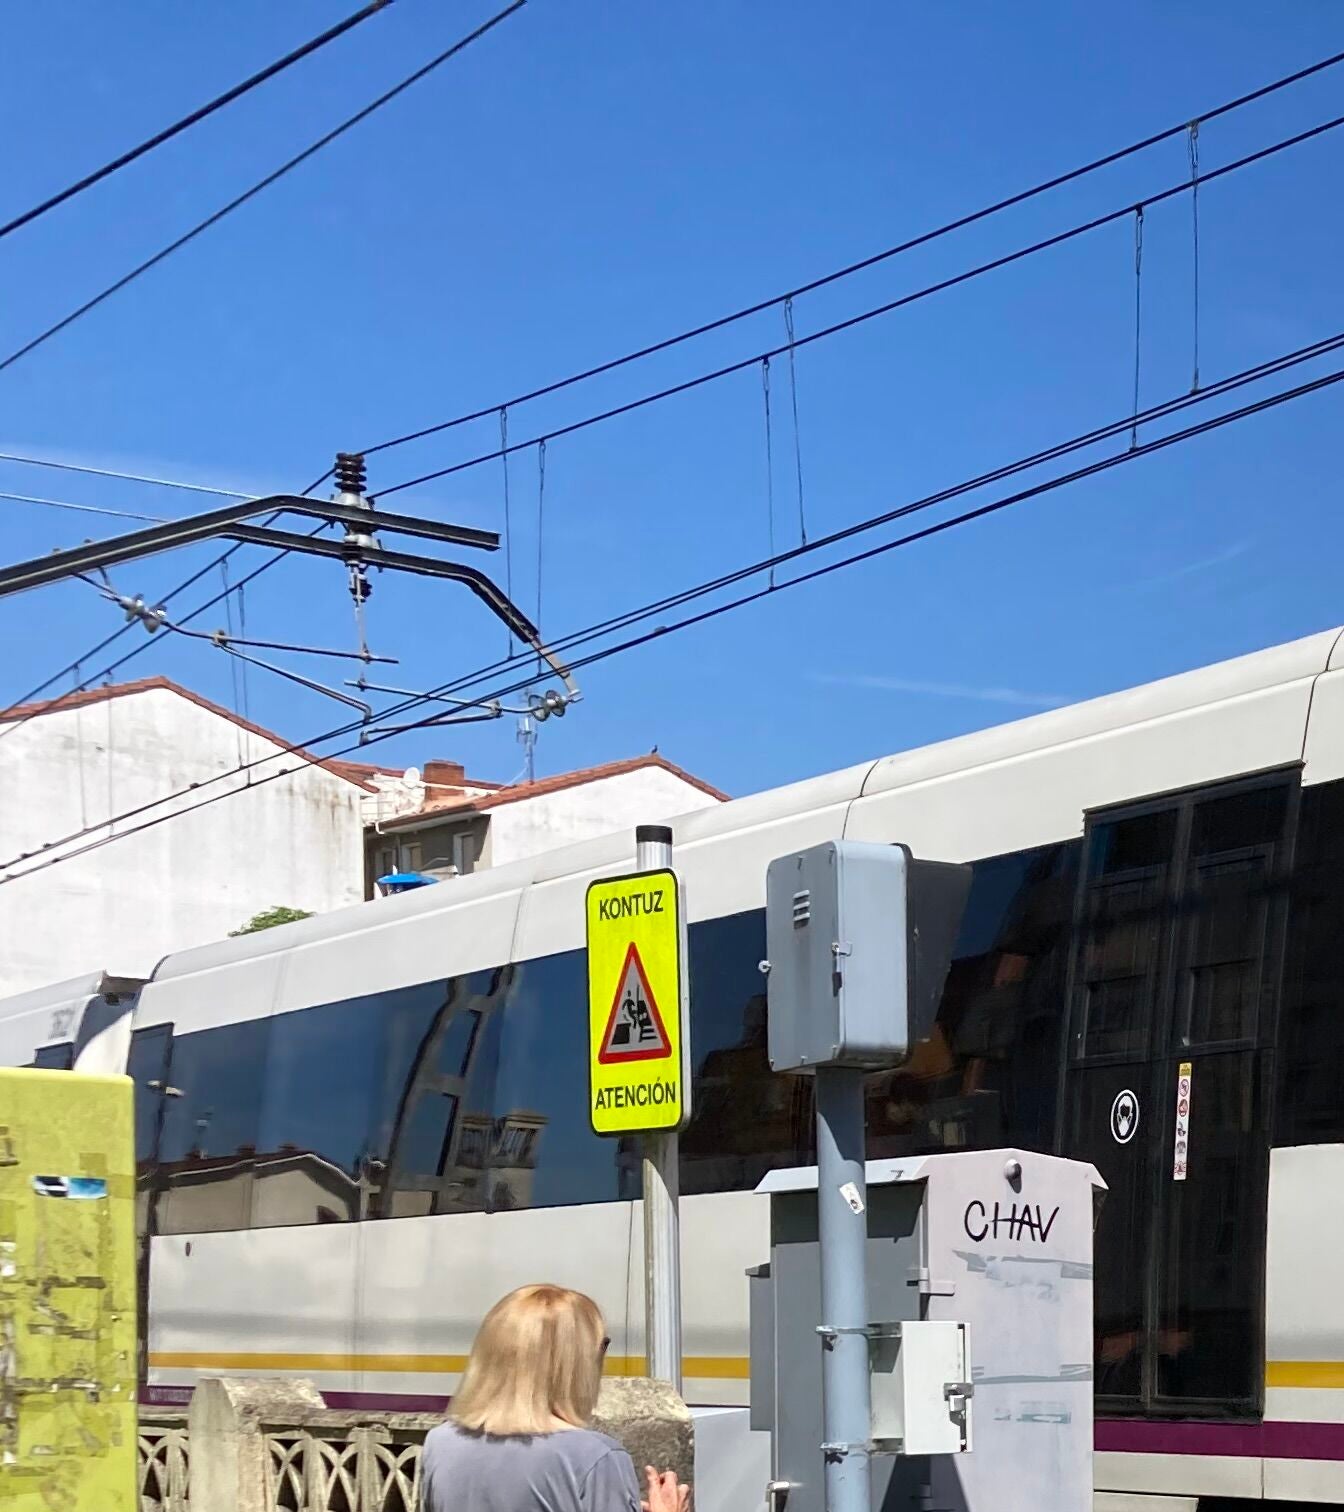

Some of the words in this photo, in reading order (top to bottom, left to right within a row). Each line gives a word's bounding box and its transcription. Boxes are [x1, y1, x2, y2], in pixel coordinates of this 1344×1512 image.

[599, 890, 664, 921] KONTUZ
[595, 1076, 676, 1110] ATENCIÓN
[963, 1200, 1060, 1243] CHAV
